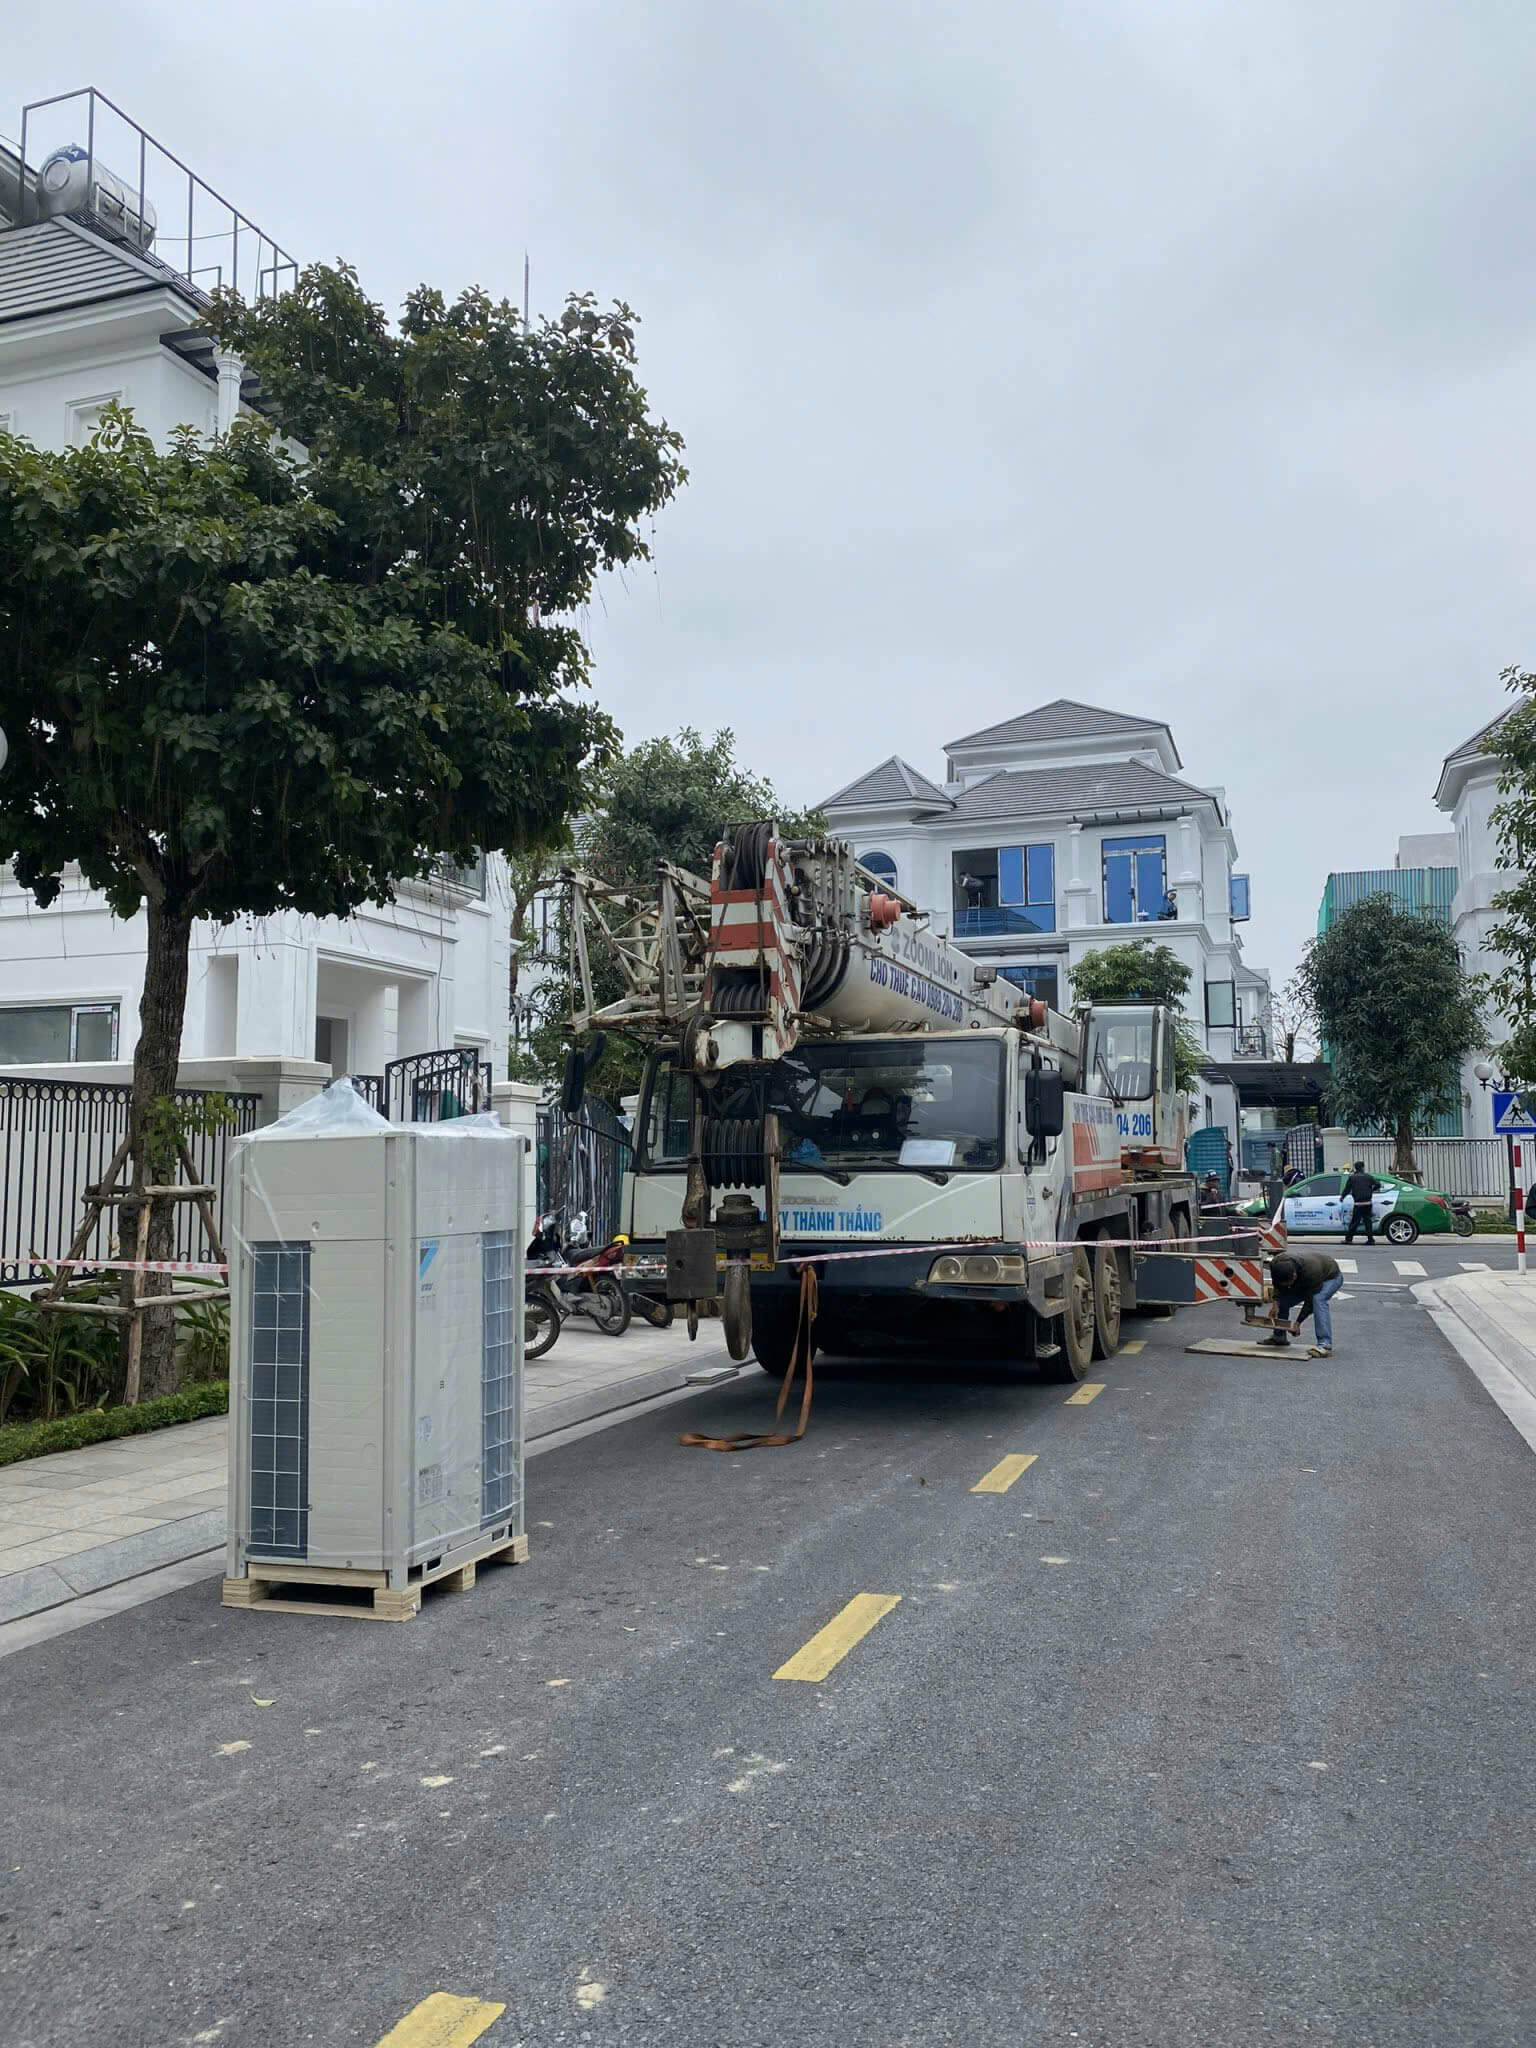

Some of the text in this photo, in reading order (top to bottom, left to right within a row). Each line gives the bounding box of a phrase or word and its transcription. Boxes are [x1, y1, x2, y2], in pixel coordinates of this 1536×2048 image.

[903, 931, 953, 984] ZOOMLION
[870, 959, 888, 986] CHO
[1132, 1113, 1151, 1136] 206
